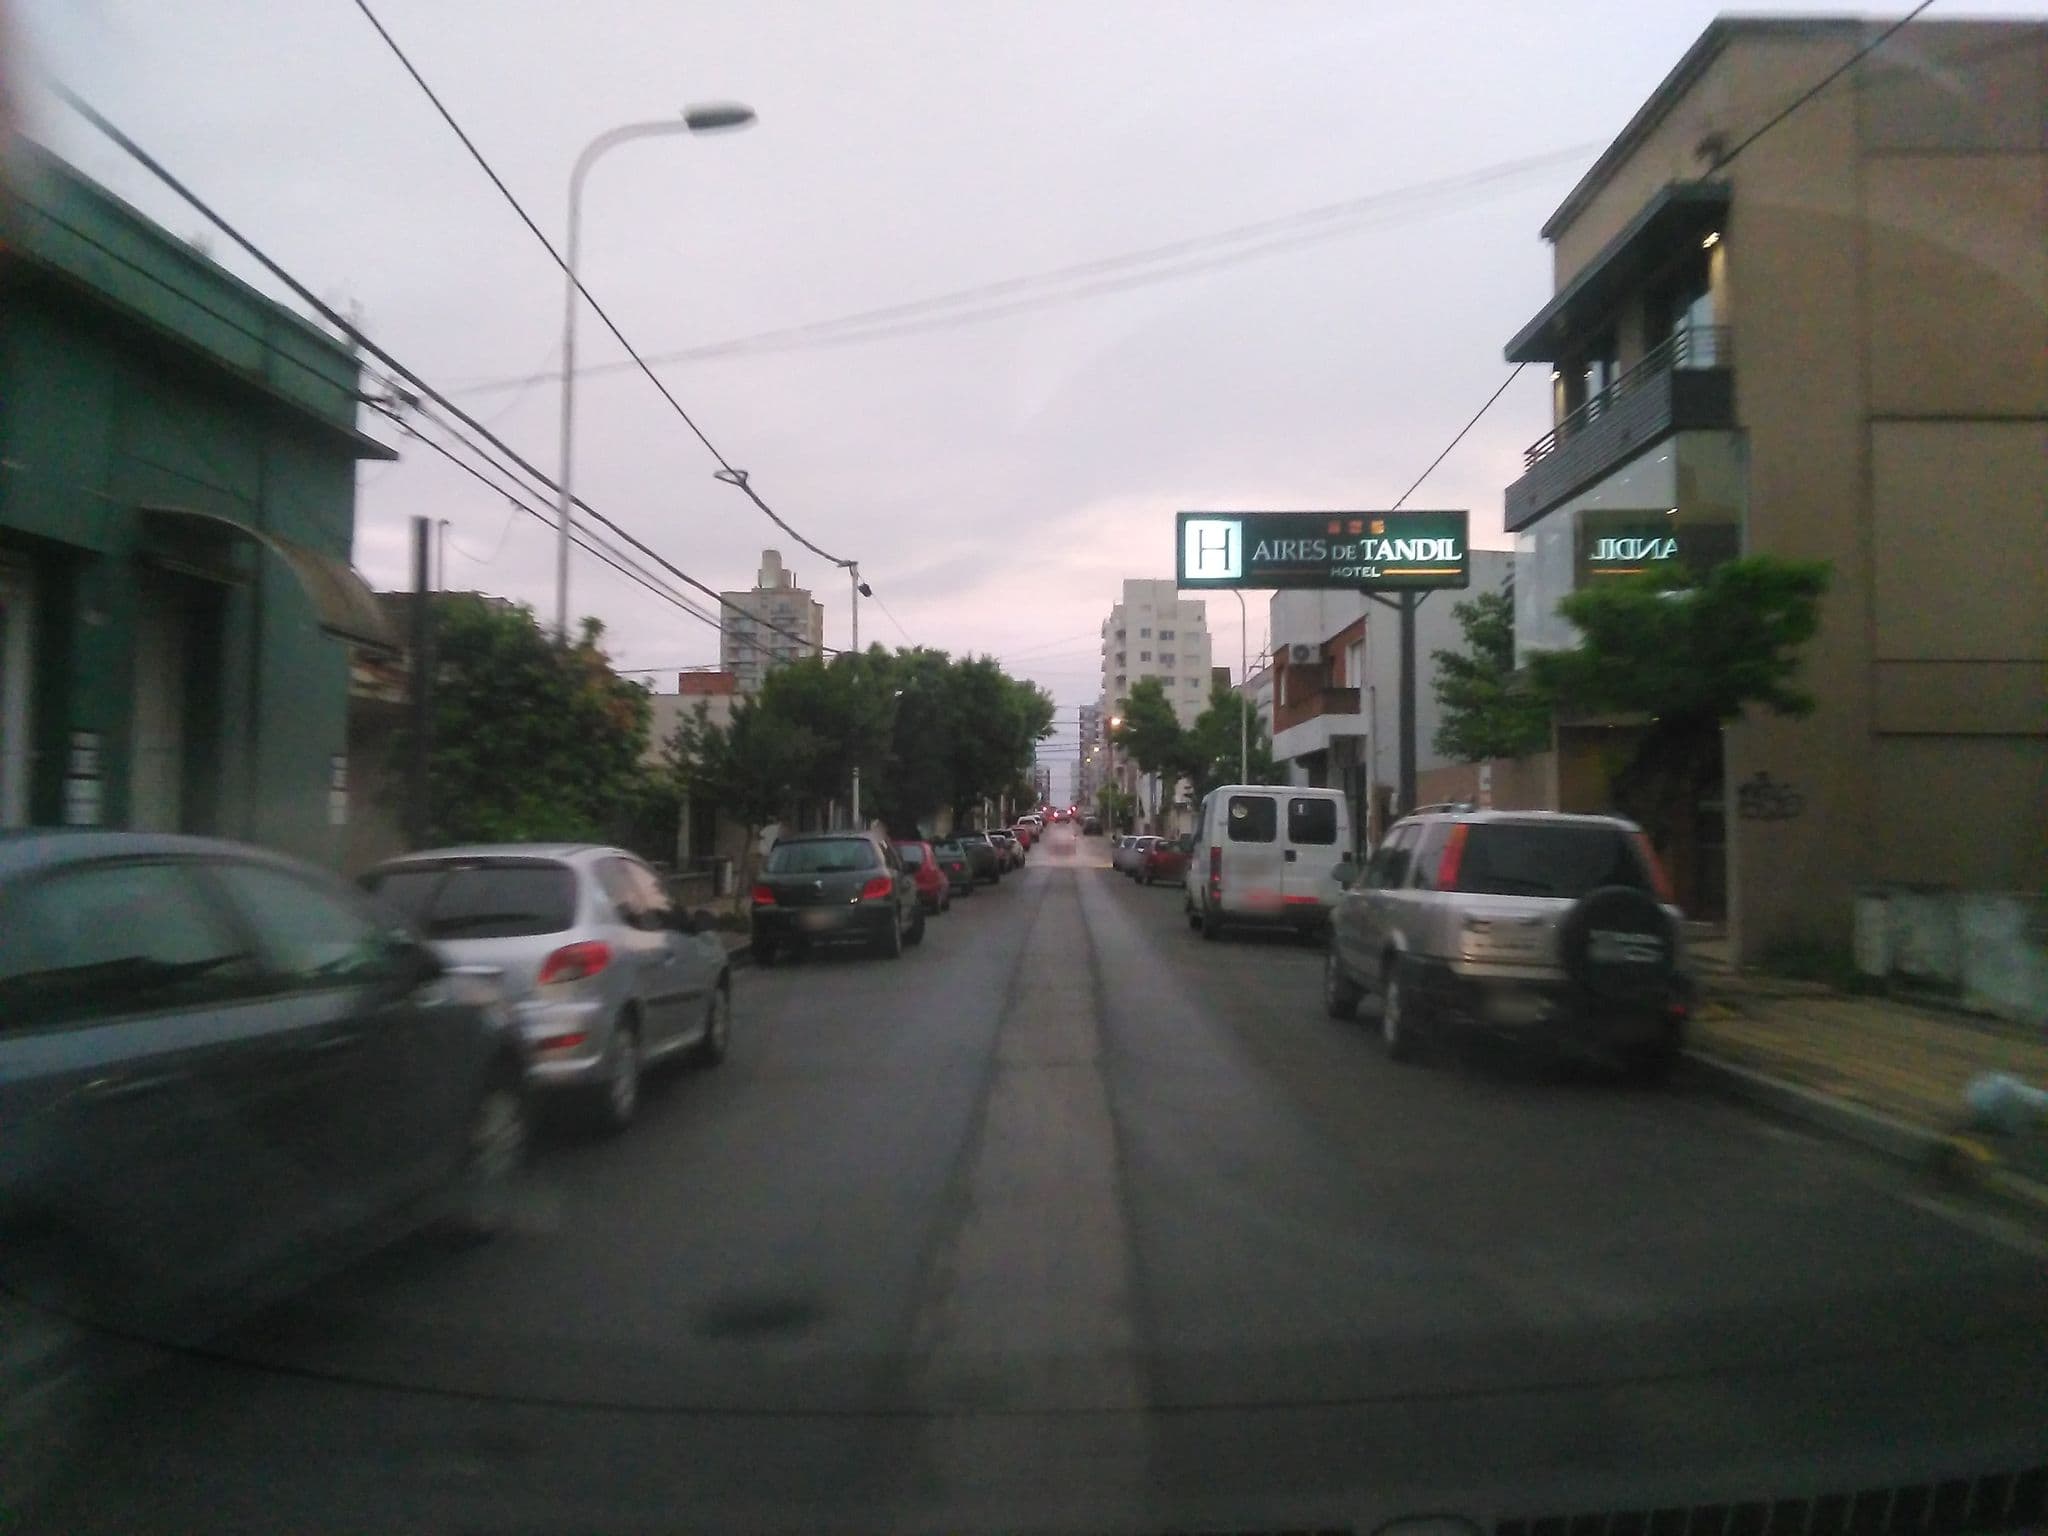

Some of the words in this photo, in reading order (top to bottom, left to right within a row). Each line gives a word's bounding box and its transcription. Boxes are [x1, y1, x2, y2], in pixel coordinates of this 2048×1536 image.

[1199, 529, 1231, 570] H
[1252, 539, 1326, 561] AIRES
[1332, 545, 1357, 561] DE
[1361, 538, 1462, 561] TANDIL
[1331, 567, 1381, 578] HOTEL
